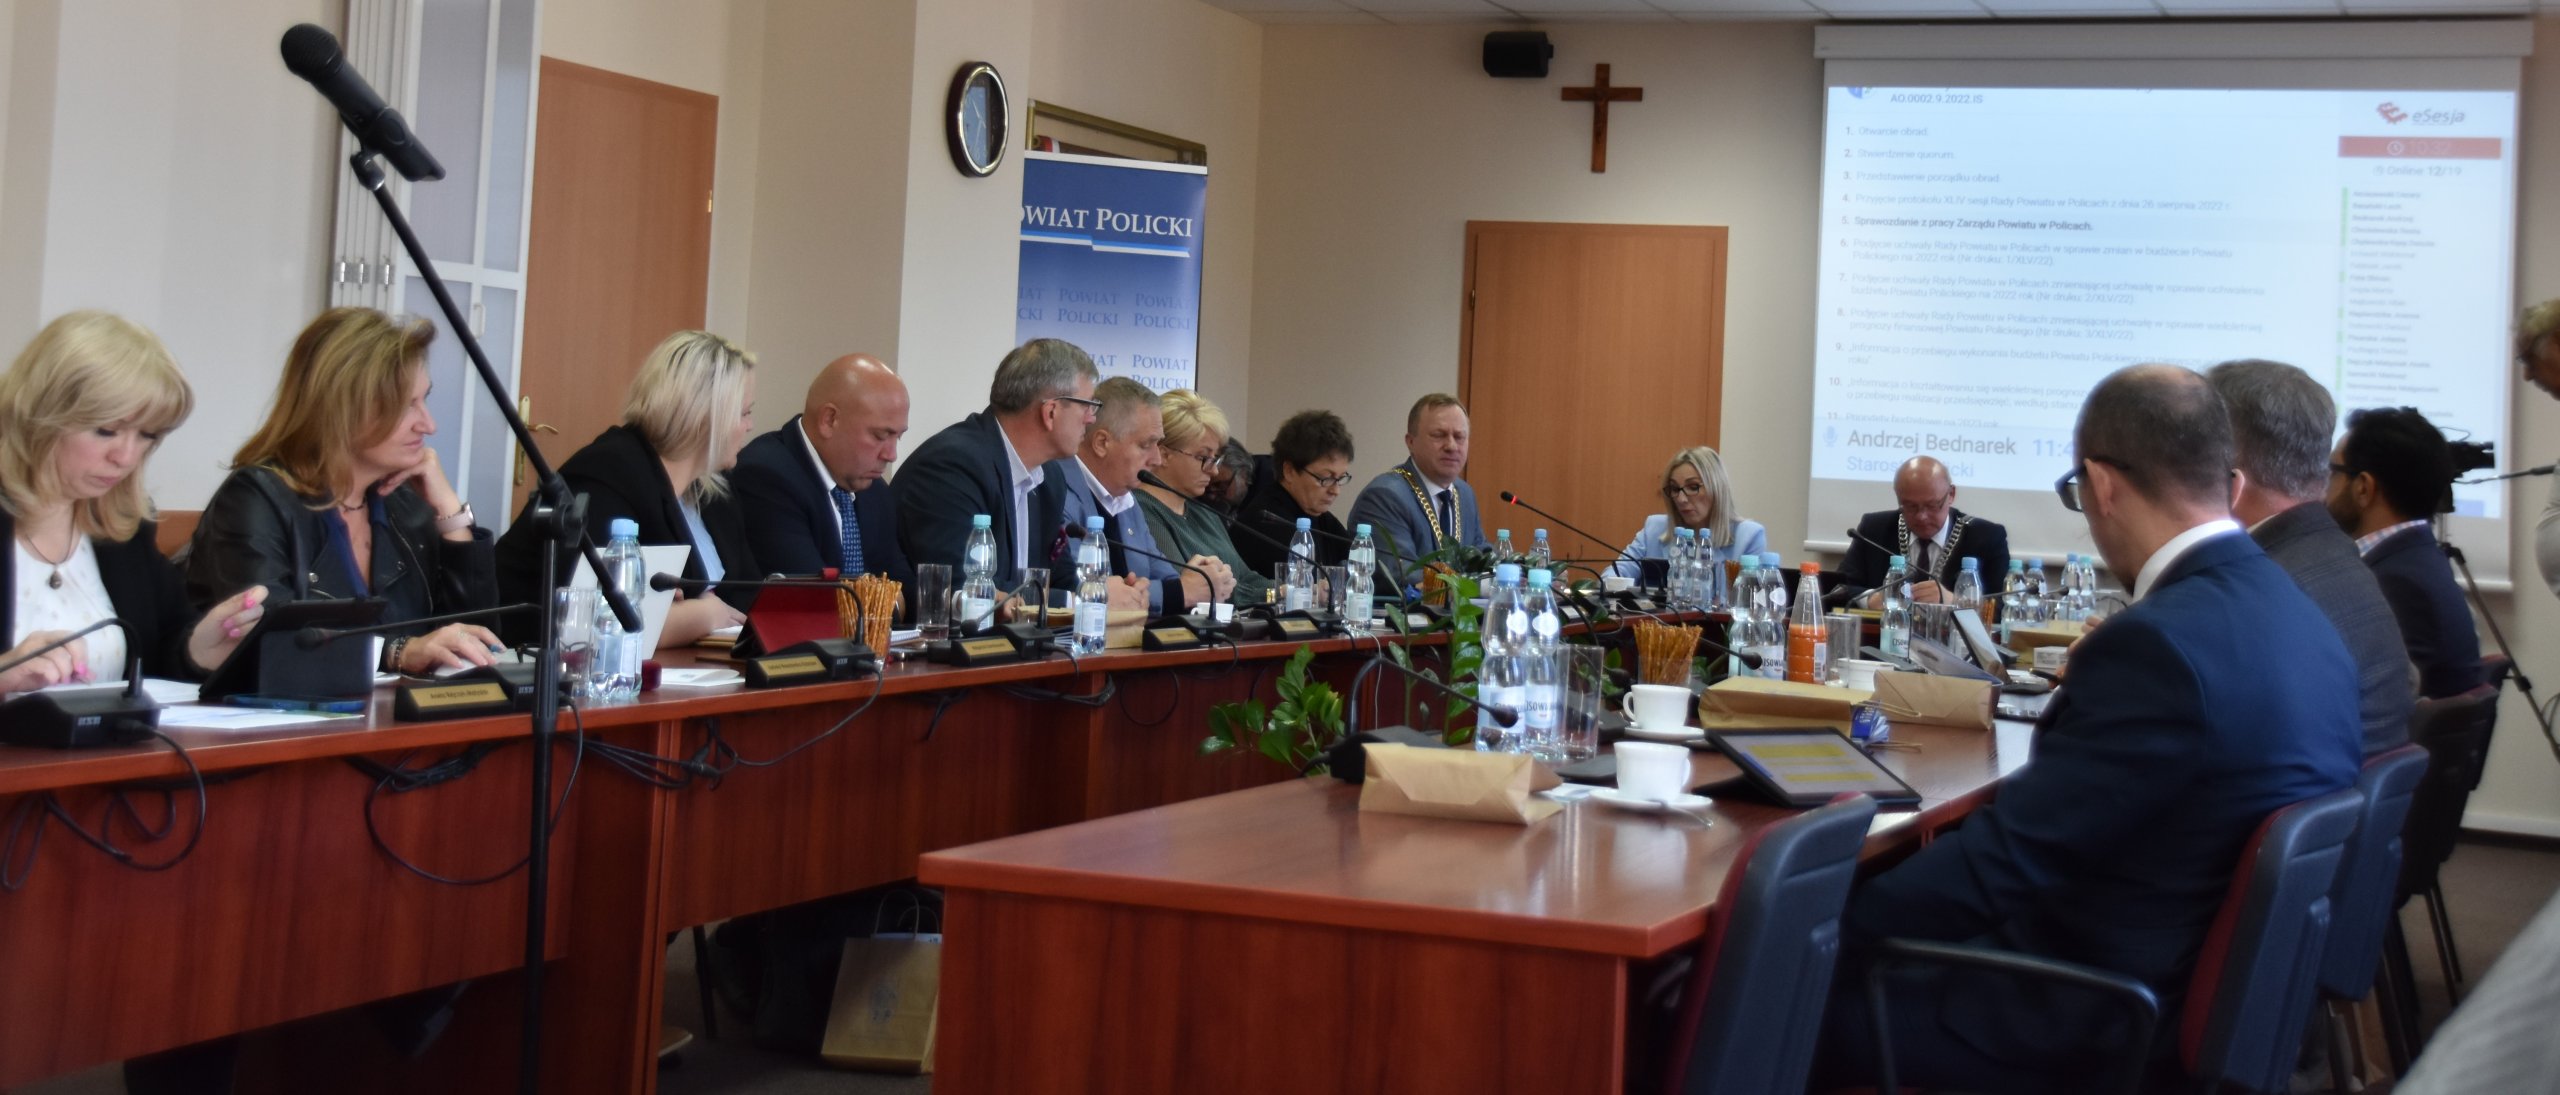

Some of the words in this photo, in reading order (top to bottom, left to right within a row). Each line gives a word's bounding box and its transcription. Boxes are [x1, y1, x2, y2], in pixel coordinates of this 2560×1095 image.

[2412, 108, 2465, 126] eSesja
[1845, 126, 1854, 136] 1.
[1858, 126, 1899, 136] Otwarcie
[1844, 149, 1853, 158] 2.
[1857, 149, 1916, 160] Stwierdzenie
[1843, 171, 1852, 181] 3.
[1856, 171, 1926, 182] Przedstawienie
[1927, 173, 1970, 184] porządku
[1841, 193, 1850, 202] 4.
[1990, 196, 2015, 209] Rady
[2016, 197, 2056, 208] Powiatu
[2067, 198, 2109, 209] Policach
[2119, 200, 2140, 209] dnia
[1020, 205, 1090, 229] WIAT
[1095, 207, 1193, 238] POLICKI
[1841, 215, 1850, 225] 5.
[1854, 215, 1919, 228] Sprawozdanie
[1928, 219, 1955, 230] pracy
[1956, 217, 1995, 230] Zarządu
[1997, 218, 2036, 230] Powiatu
[2038, 221, 2047, 229] w
[2048, 219, 2093, 231] Policach.
[1839, 238, 1849, 248] 6.
[1894, 240, 1932, 252] uchwały
[1933, 240, 1957, 252] Rady
[1959, 241, 1998, 252] Powiatu
[1999, 244, 2008, 252] w
[2010, 243, 2051, 254] Policach
[2063, 245, 2101, 256] sprawie
[2102, 246, 2133, 255] zmian
[2134, 248, 2144, 256] w
[2145, 246, 2190, 258] budżecie
[2191, 247, 2233, 258] Powiatu
[1851, 251, 1900, 263] Polickiego
[1900, 254, 1913, 262] na
[1914, 253, 1939, 262] 2022
[1940, 253, 1955, 262] rok
[1838, 272, 1848, 282] 7.
[1892, 275, 1930, 287] uchwały
[1932, 276, 1956, 287] Rady
[1957, 276, 1997, 288] Powiatu
[2008, 278, 2050, 289] Policach
[1020, 288, 1044, 301] IAT
[1058, 287, 1120, 306] POWIAT
[1889, 287, 1928, 298] Powiatu
[1928, 288, 1977, 300] Polickiego
[1978, 291, 1991, 299] na
[1992, 290, 2017, 300] 2022
[2018, 290, 2034, 300] rok
[1057, 307, 1119, 326] POLICKI
[1836, 307, 1846, 317] 8.
[1890, 310, 1930, 322] uchwały
[1931, 311, 1954, 322] Rady
[1956, 312, 1995, 323] Powiatu
[1996, 315, 2005, 323] w
[2007, 313, 2049, 325] Policach
[2154, 319, 2164, 327] w
[1849, 320, 1892, 332] prognozy
[1893, 321, 1944, 334] finansowej
[1945, 323, 1983, 335] Powiatu
[1984, 325, 2034, 337] Polickiego
[1835, 341, 1844, 351] 9.
[1911, 345, 1957, 358] przebiegu
[1958, 348, 2008, 359] wykonania
[2009, 349, 2049, 360] budżetu
[2050, 350, 2090, 362] Powiatu
[1090, 353, 1117, 367] IAT
[1132, 353, 1189, 371] POWIAT
[1828, 376, 1843, 387] 10.
[1909, 379, 1974, 392] kształtowaniu
[1975, 385, 1990, 395] się
[1854, 391, 1900, 403] przebiegu
[2014, 396, 2048, 410] według
[1847, 429, 1919, 455] Andrzej
[1925, 433, 2017, 456] Bednarek
[2031, 438, 2075, 457] 11:4
[1846, 455, 1901, 473] Staros
